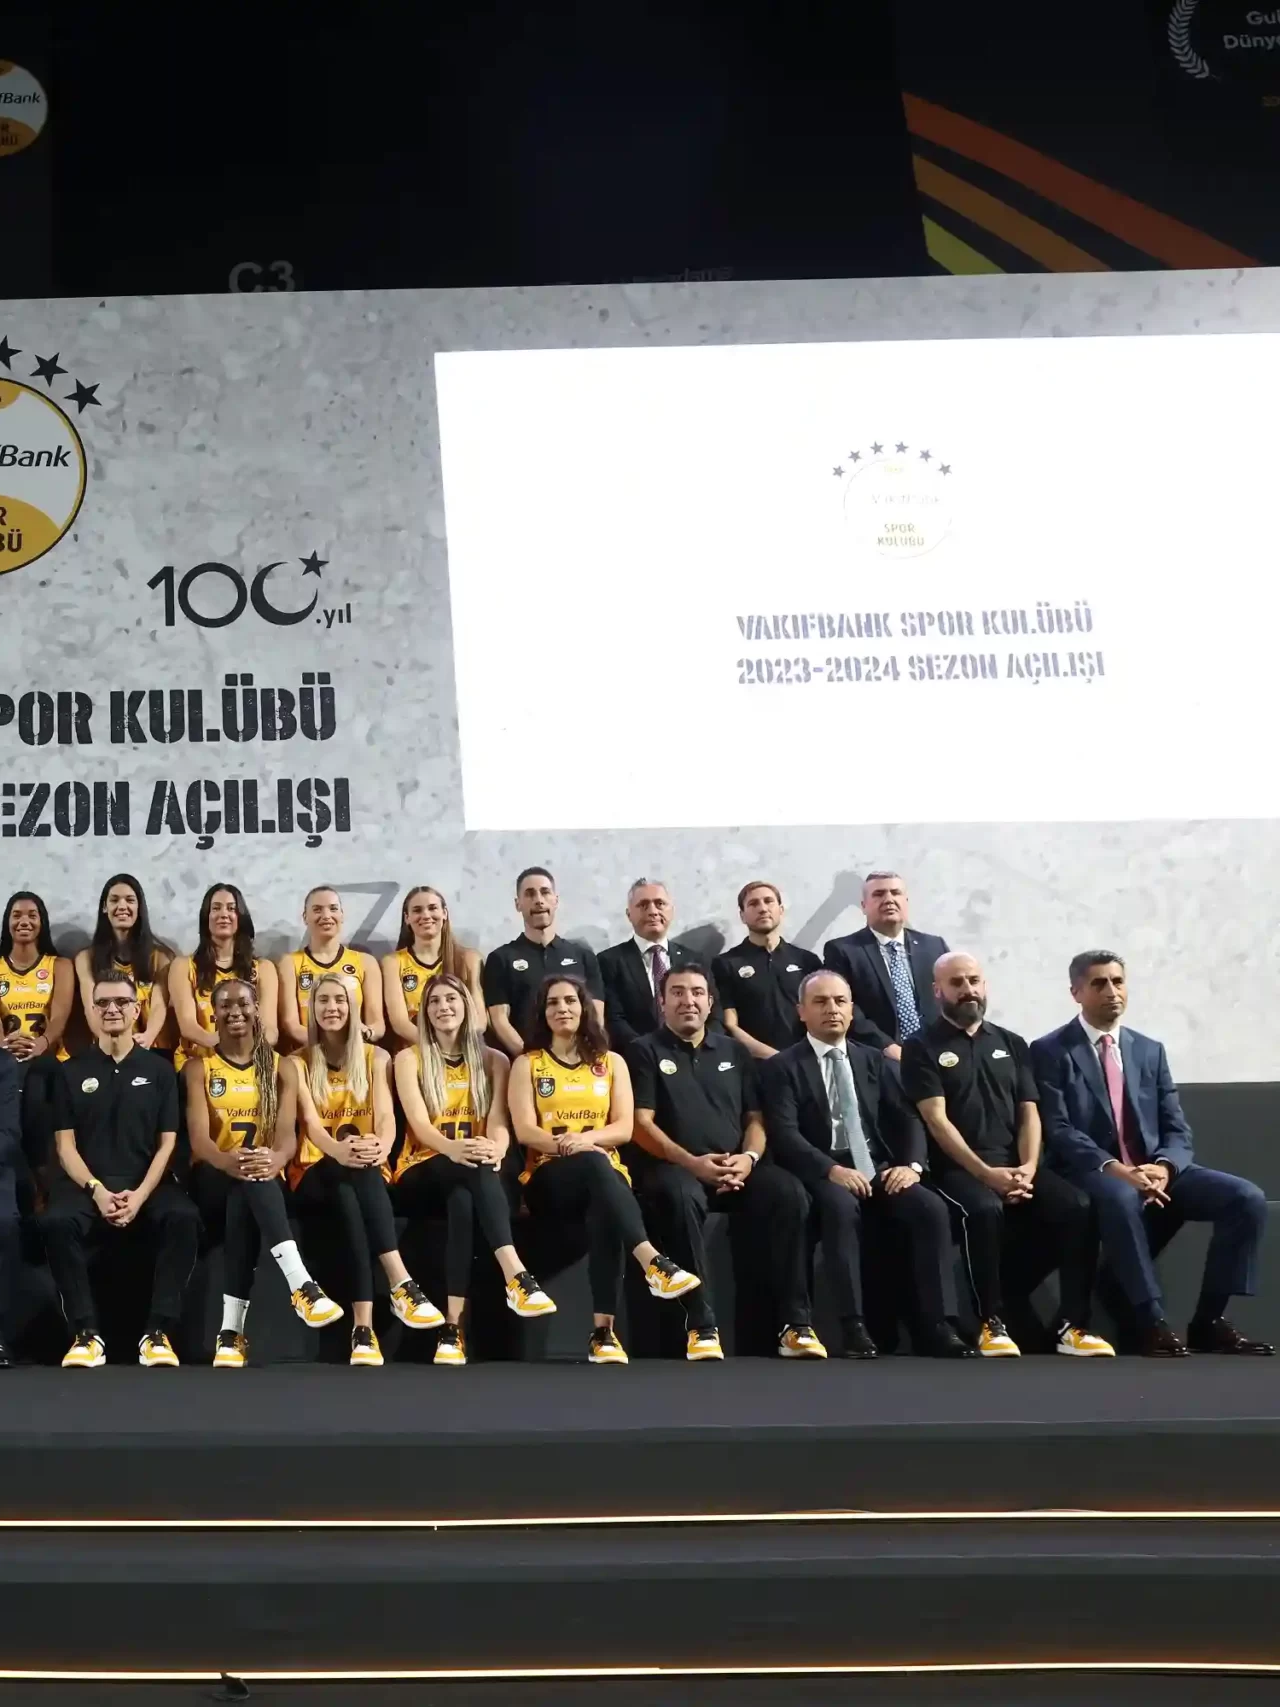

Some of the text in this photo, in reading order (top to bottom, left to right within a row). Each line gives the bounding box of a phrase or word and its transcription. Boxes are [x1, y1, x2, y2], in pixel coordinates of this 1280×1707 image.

[228, 260, 296, 292] C3
[736, 600, 1093, 640] VAKIFBANK SPOR KULÜBÜ
[737, 651, 1105, 685] 2023-2024 SEZON AÇILIŞI
[110, 672, 337, 744] KULÜBÜ
[146, 777, 351, 850] AÇILIŞI
[8, 1002, 47, 1011] VakıfBan
[226, 1108, 260, 1117] VakıfB
[231, 1122, 258, 1148] 7
